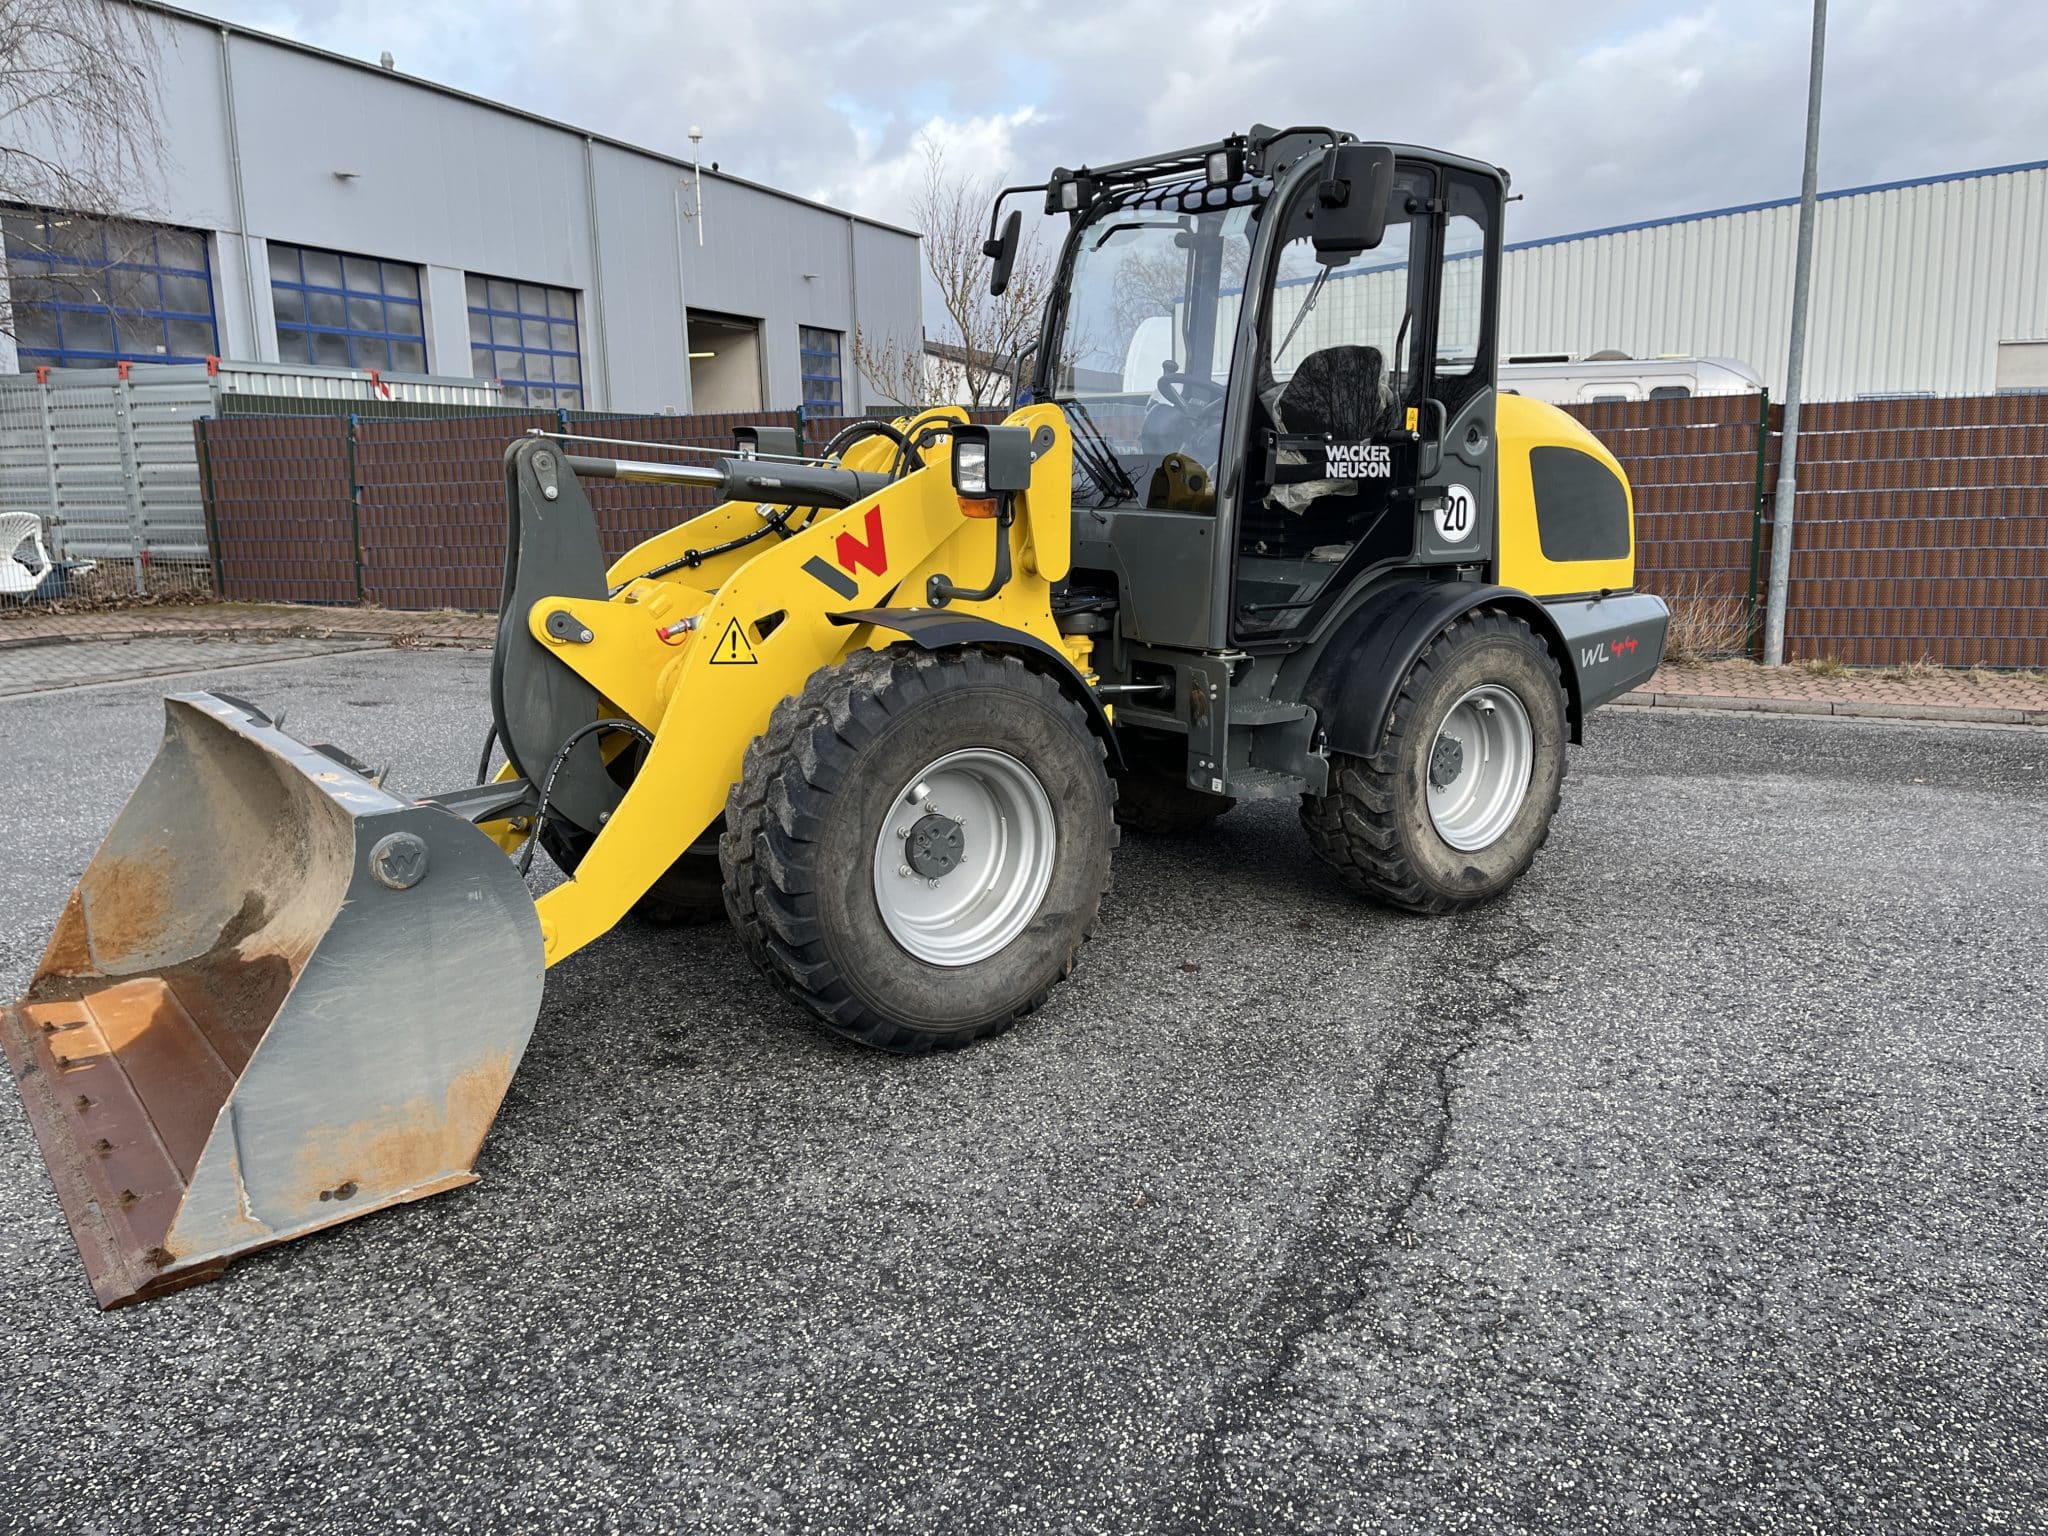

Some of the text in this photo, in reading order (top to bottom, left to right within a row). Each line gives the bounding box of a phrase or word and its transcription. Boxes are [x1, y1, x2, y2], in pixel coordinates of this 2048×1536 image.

[1325, 445, 1390, 462] WACKER
[1326, 462, 1390, 478] NEUSON
[1442, 496, 1467, 531] 20
